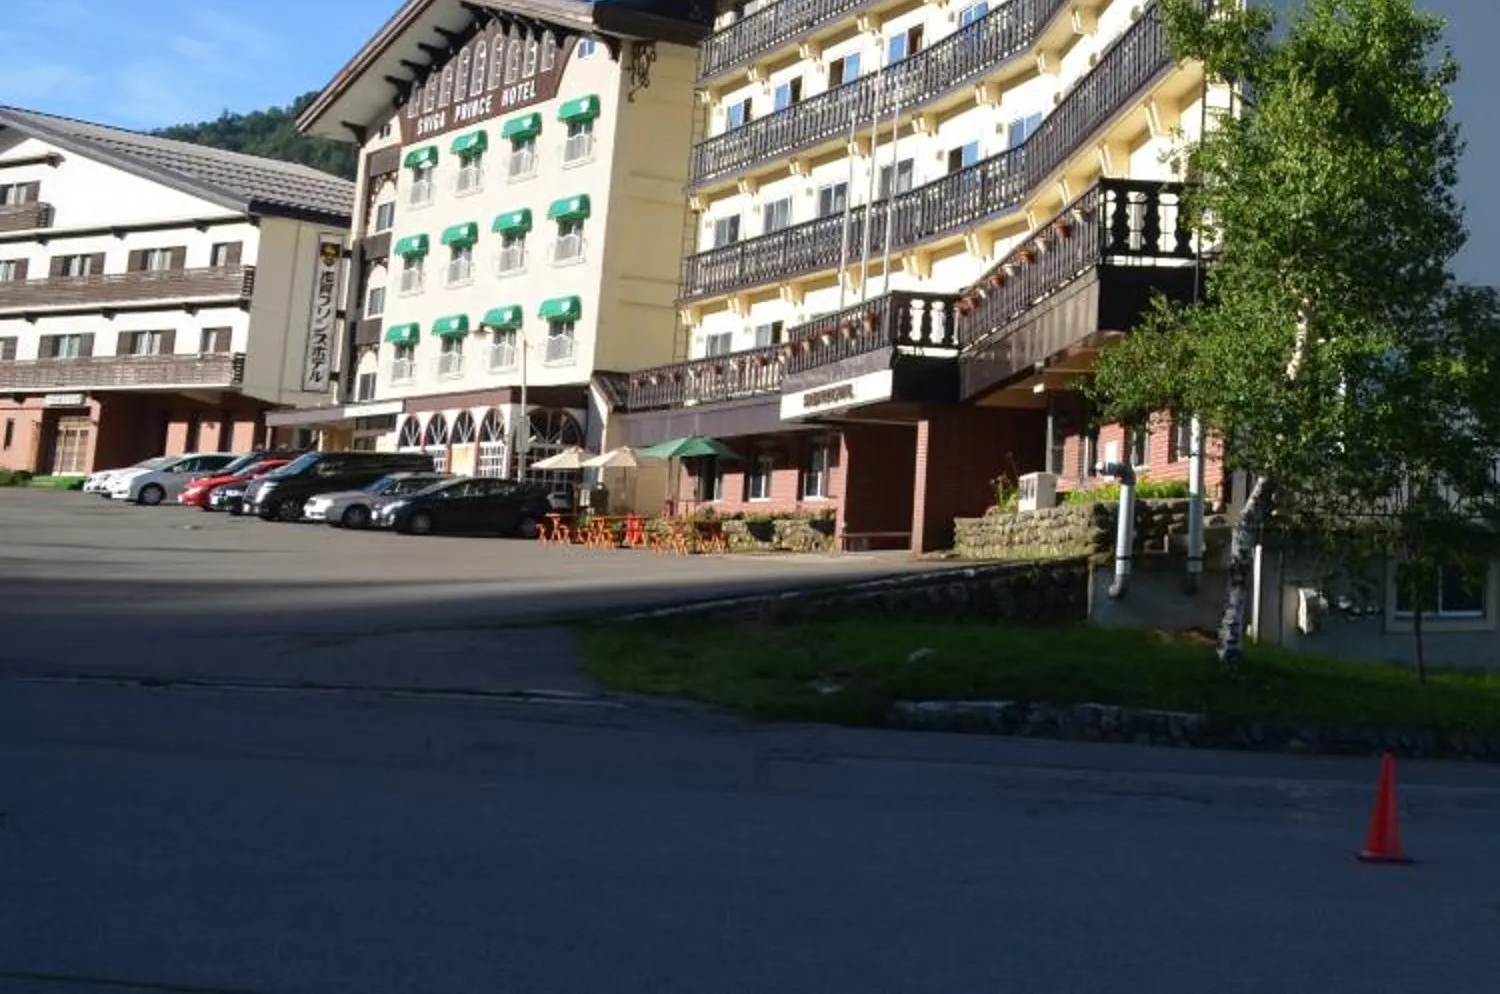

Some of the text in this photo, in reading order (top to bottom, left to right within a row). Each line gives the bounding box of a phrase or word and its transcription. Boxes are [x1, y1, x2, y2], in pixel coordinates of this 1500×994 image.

[416, 79, 536, 136] SHIGA PRINCE HOTEL
